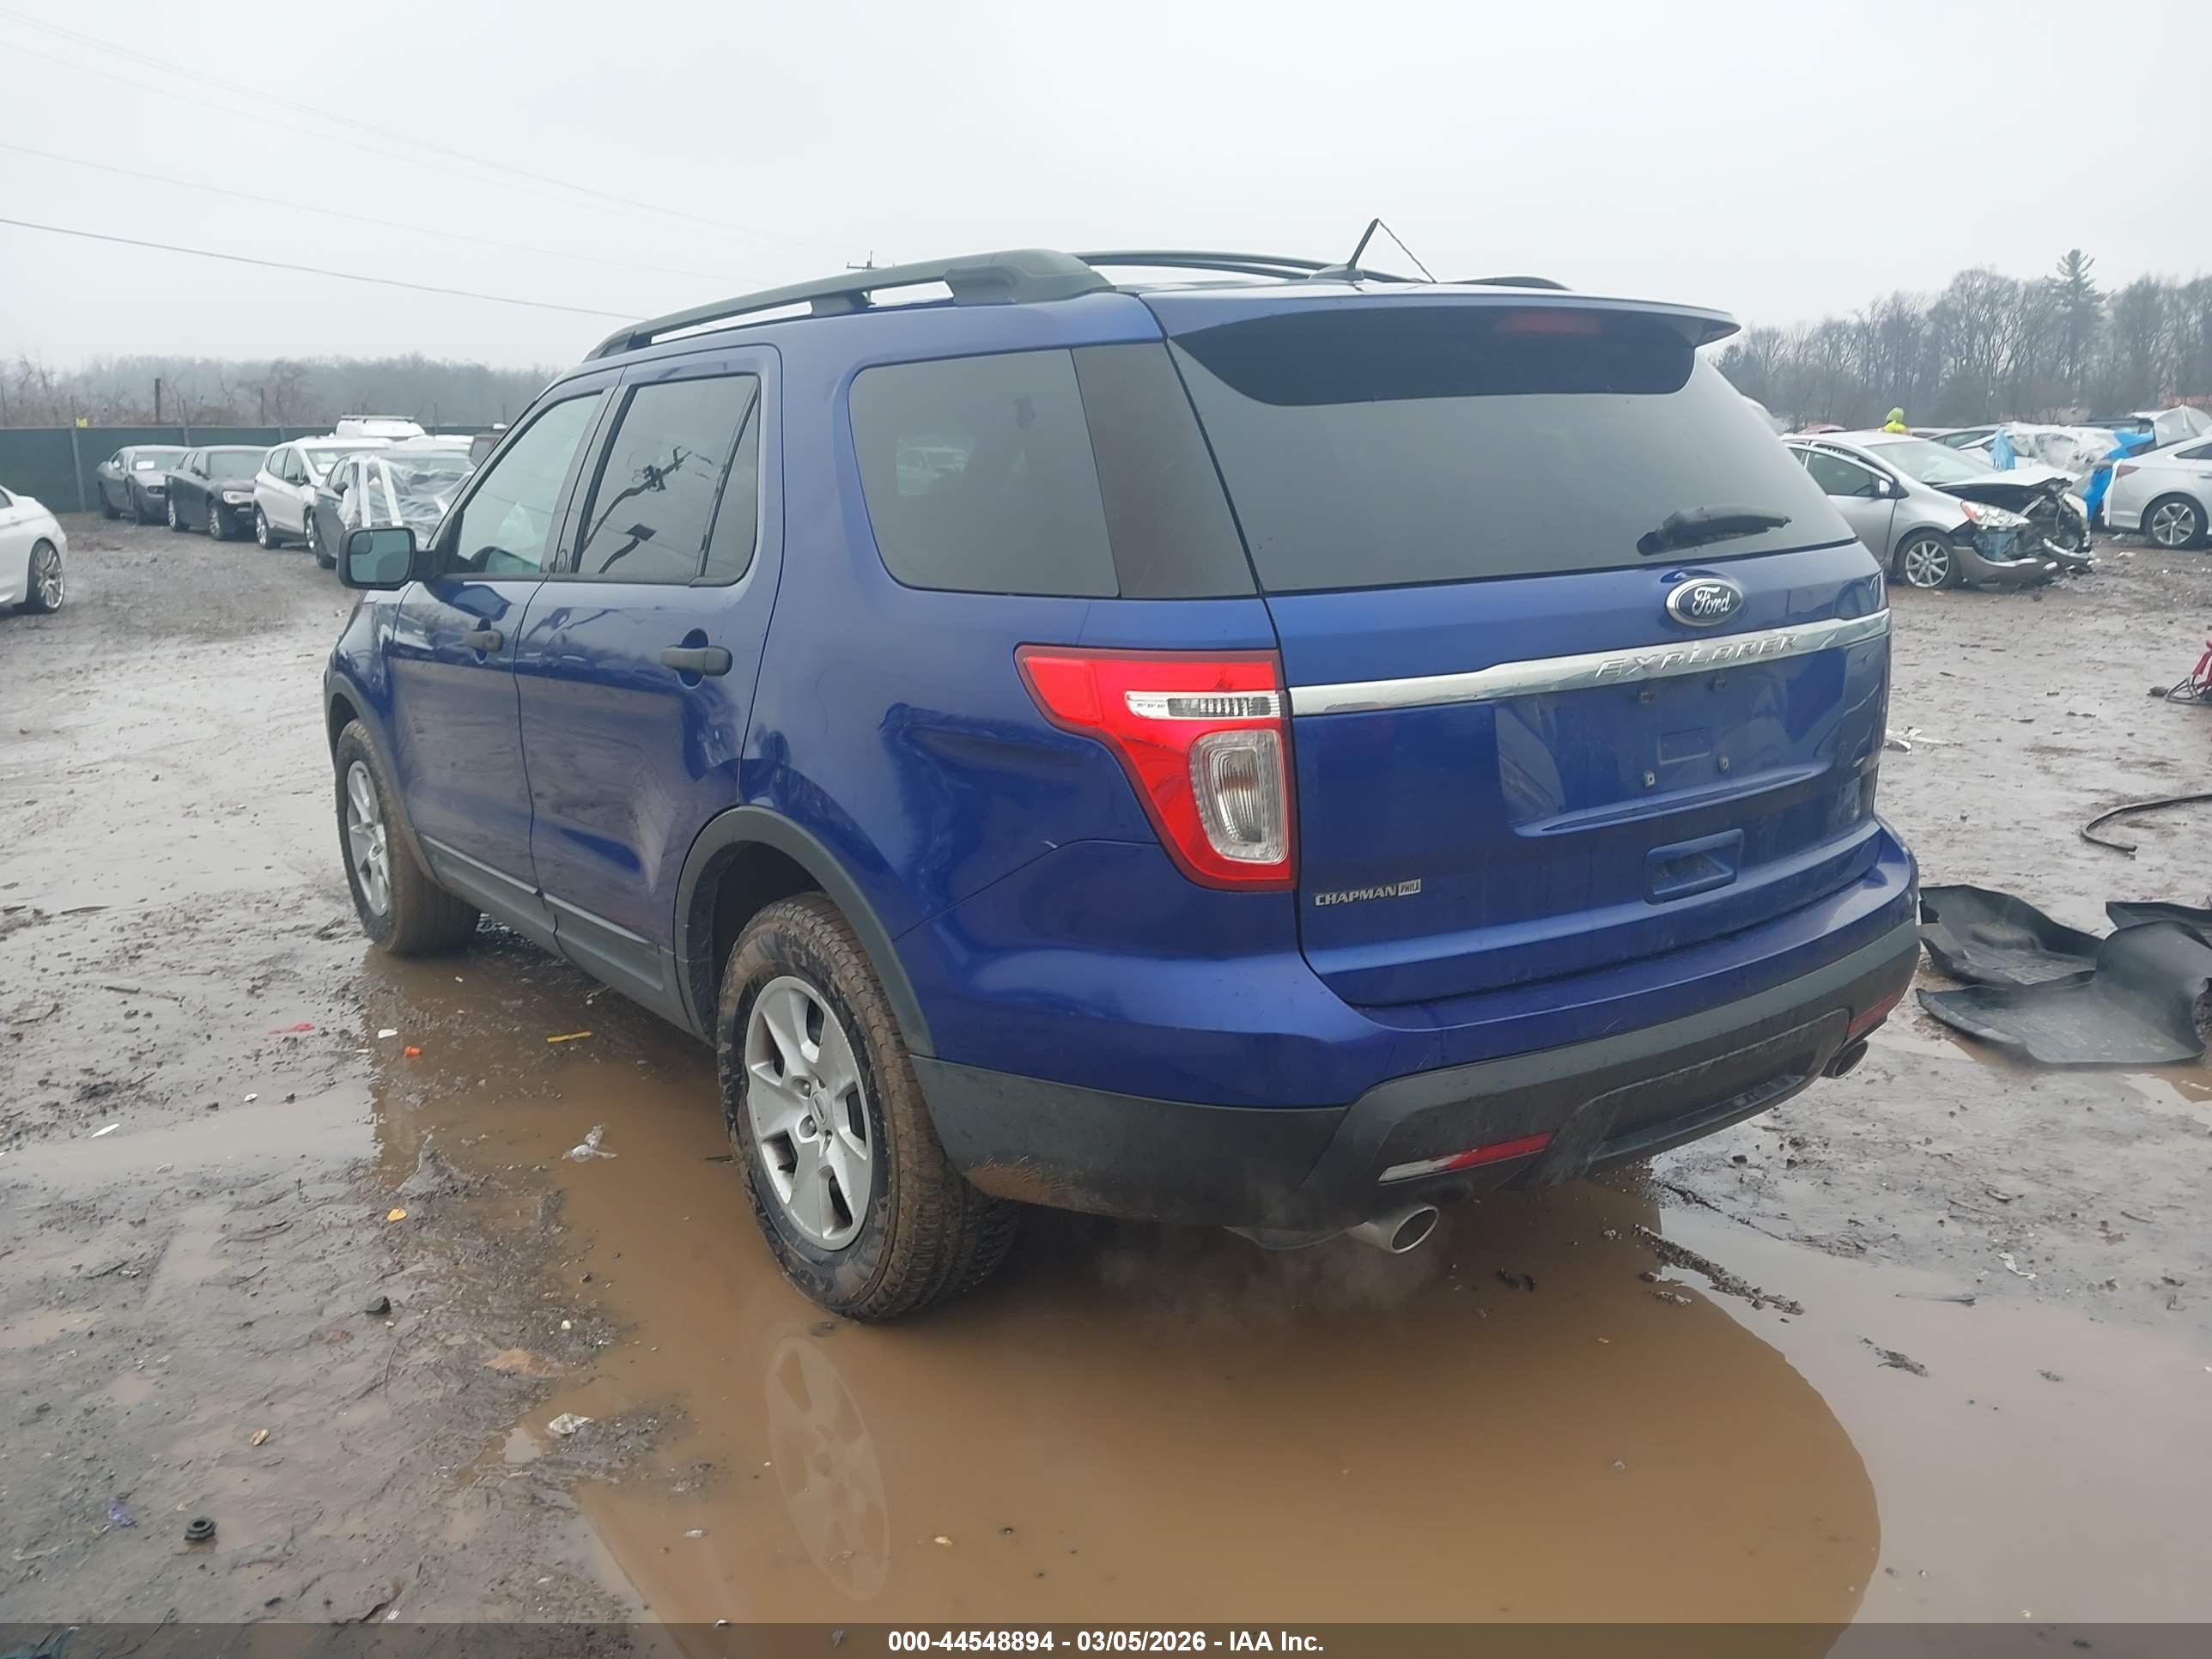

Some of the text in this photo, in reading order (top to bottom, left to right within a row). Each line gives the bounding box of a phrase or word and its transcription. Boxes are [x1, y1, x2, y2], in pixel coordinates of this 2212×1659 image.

[1692, 586, 1731, 616] Ford
[1595, 632, 1798, 679] EXPLORER
[1315, 885, 1396, 906] CHAPMAN
